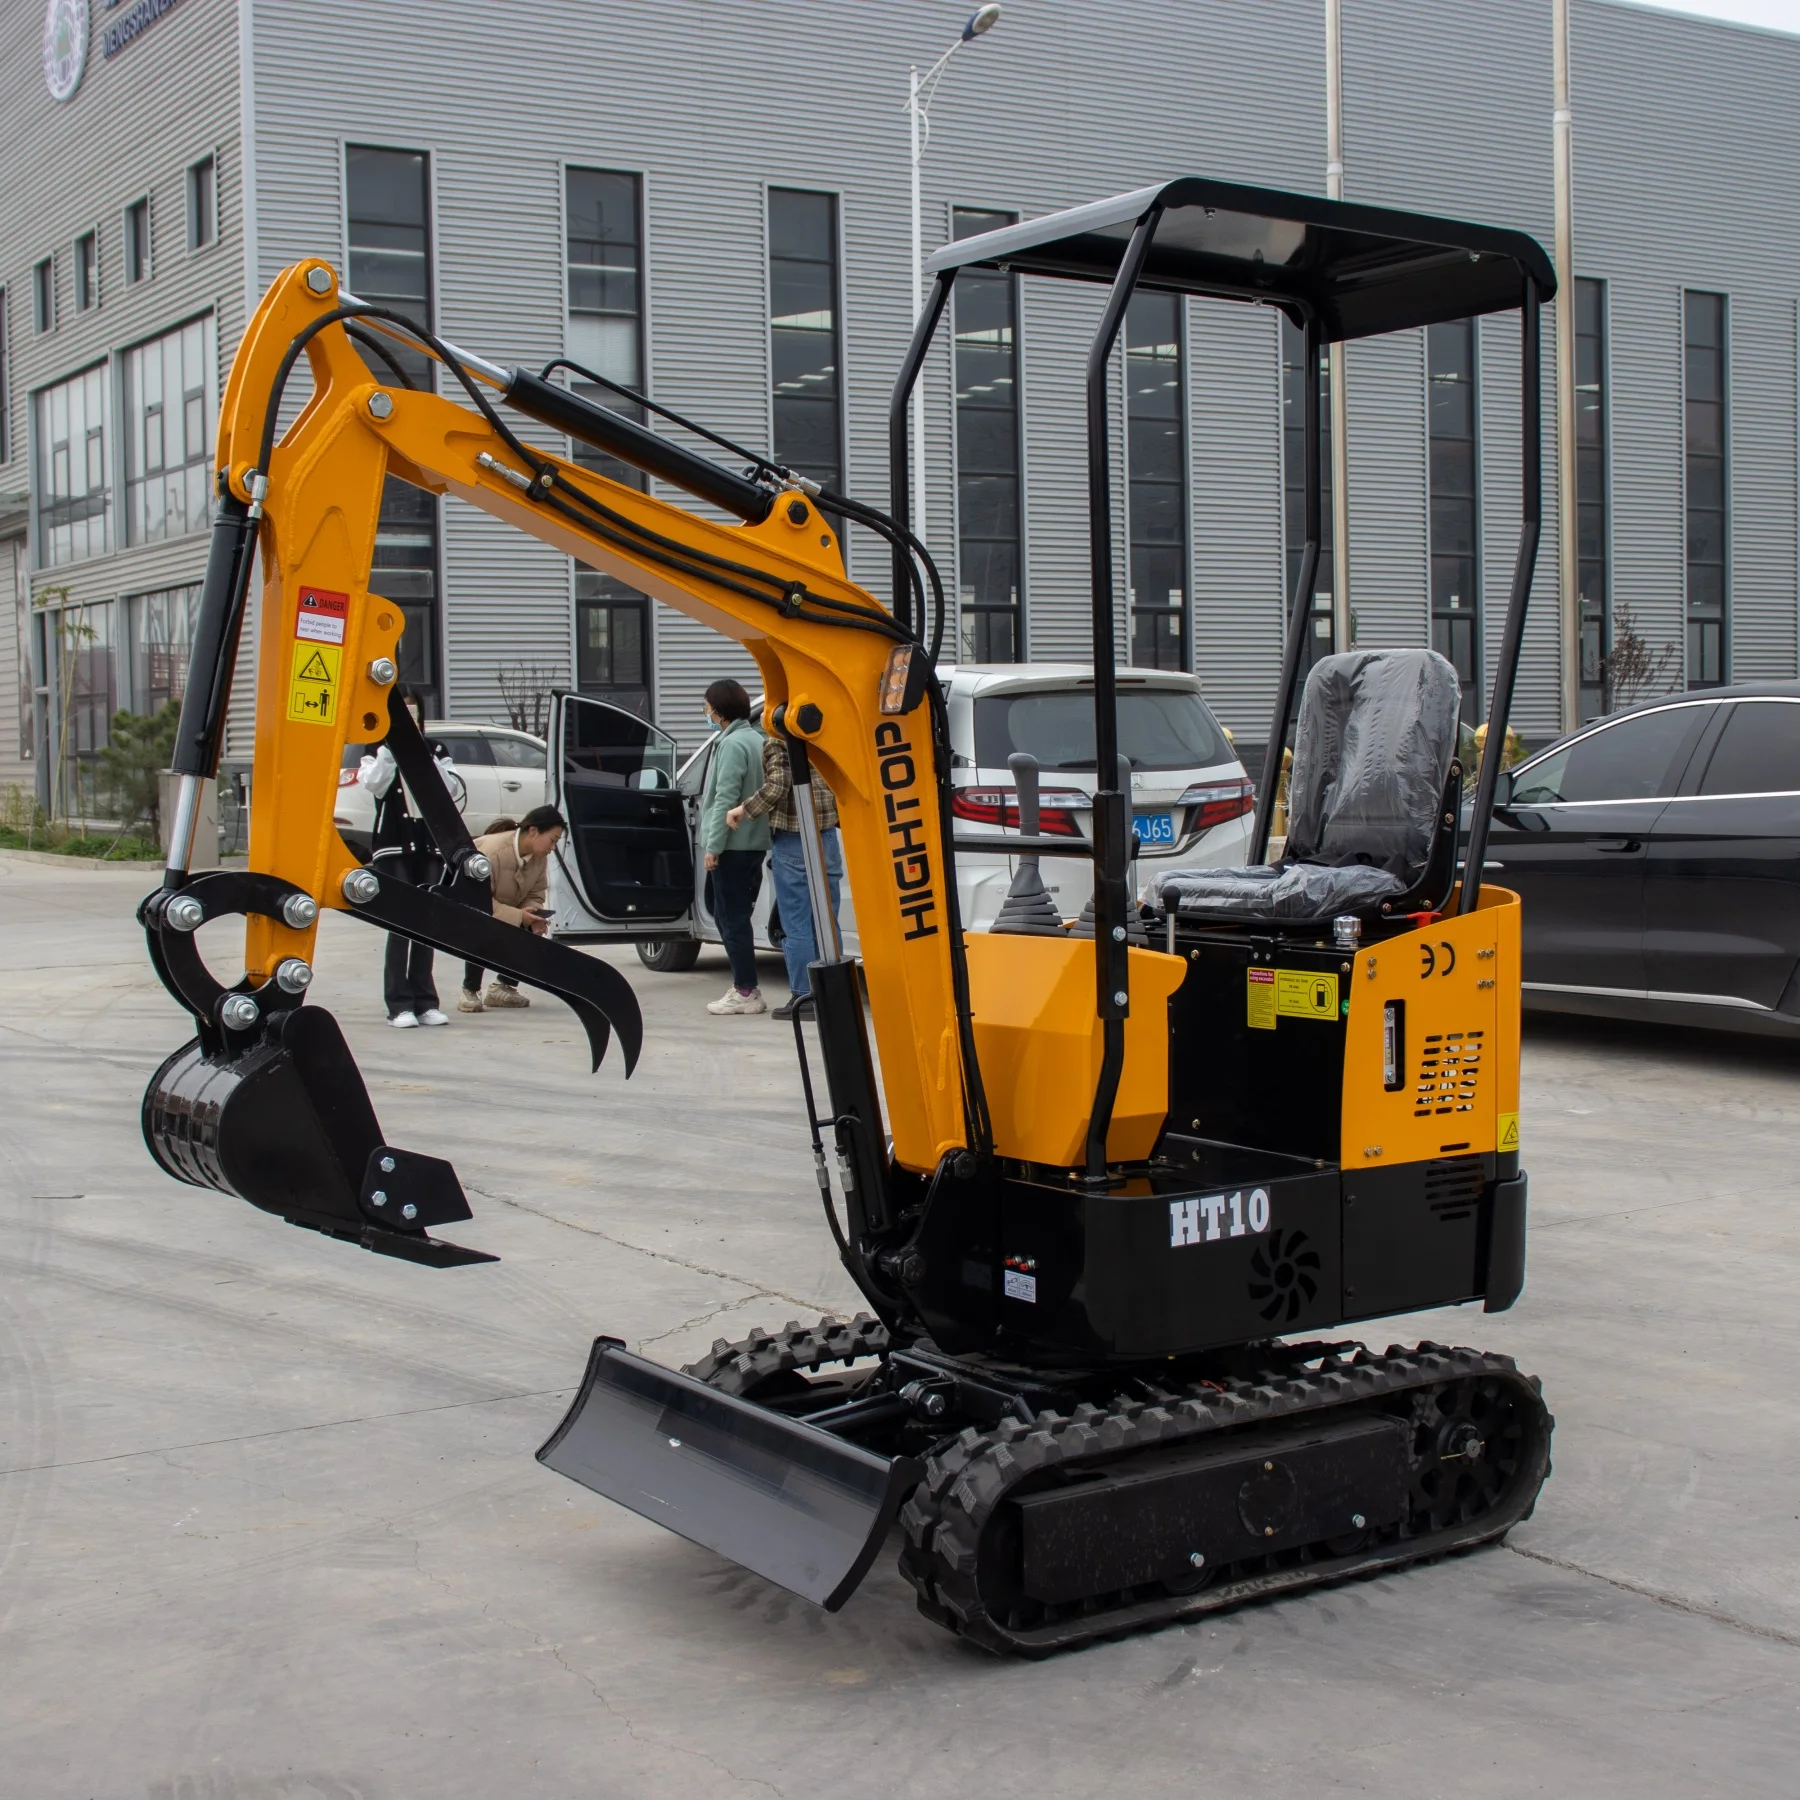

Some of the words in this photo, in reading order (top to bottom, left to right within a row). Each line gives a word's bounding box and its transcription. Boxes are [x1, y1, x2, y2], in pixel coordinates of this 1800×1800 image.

[319, 598, 345, 612] DANGER
[300, 617, 315, 626] Forbid
[315, 621, 331, 629] people
[310, 627, 322, 635] when
[323, 630, 342, 639] working
[874, 721, 939, 942] HIGHTOP
[1170, 1188, 1270, 1247] HT10
